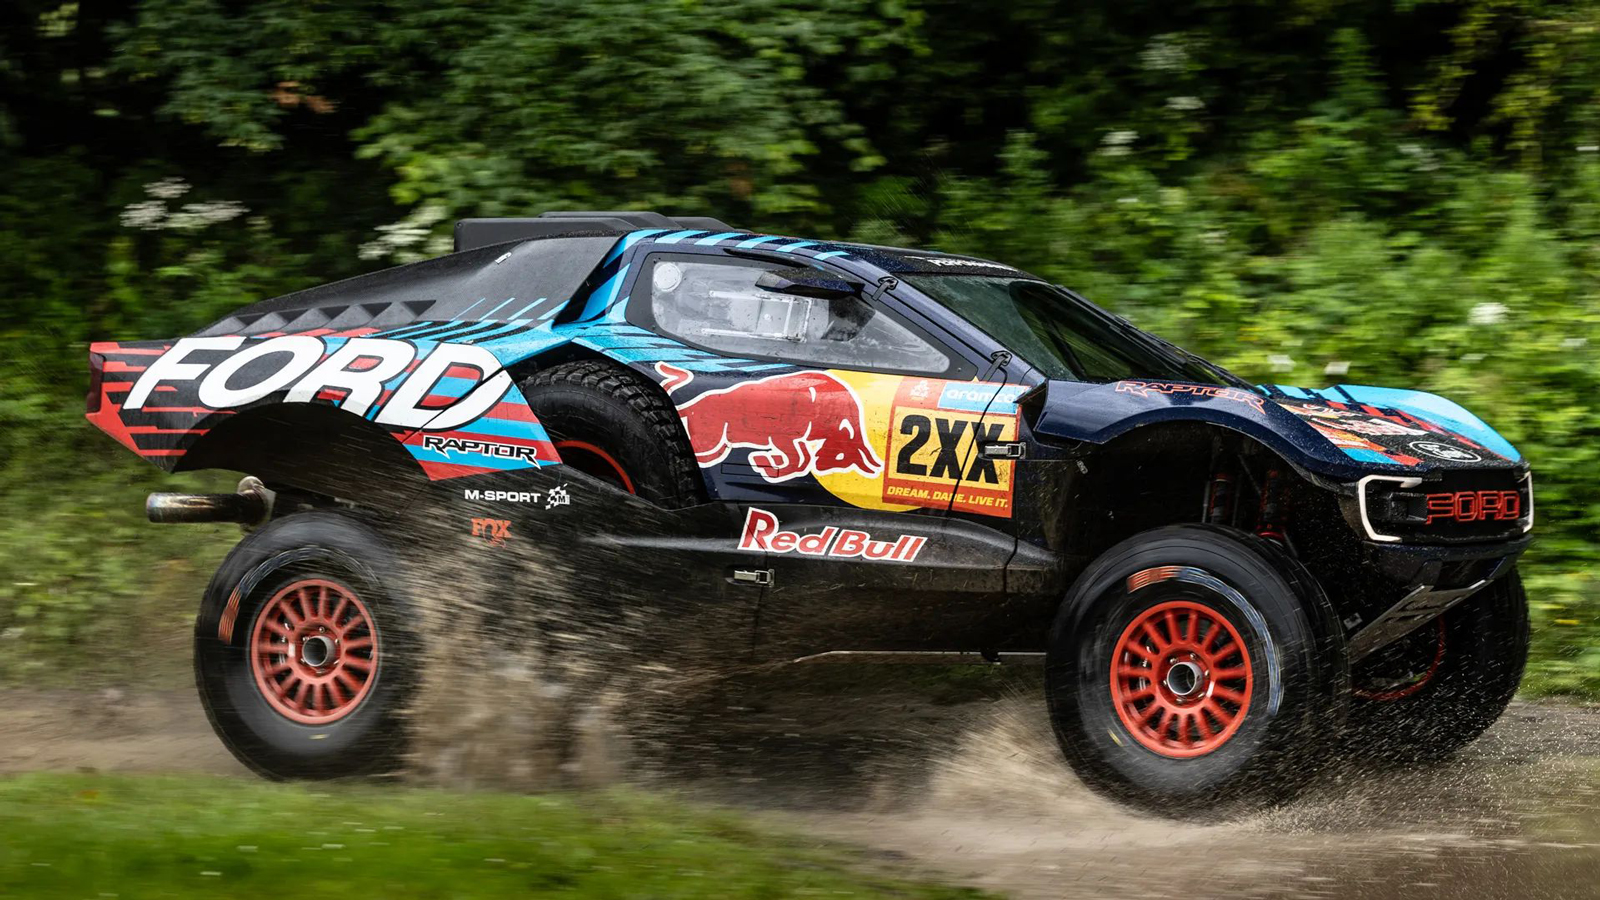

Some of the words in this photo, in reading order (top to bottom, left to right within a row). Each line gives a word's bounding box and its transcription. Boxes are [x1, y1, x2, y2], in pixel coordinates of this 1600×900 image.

[123, 336, 513, 429] FORD
[946, 389, 1015, 403] aramco
[1115, 380, 1266, 415] RAPTOR
[422, 434, 542, 470] RAPTOR
[896, 414, 1005, 485] 2XX
[464, 489, 541, 503] M-SPORT
[887, 486, 931, 499] DREAM.
[969, 495, 994, 506] LIVE
[995, 498, 1008, 507] IT.
[1426, 490, 1520, 525] FORD
[470, 517, 512, 543] FOX
[737, 506, 839, 556] Red
[828, 529, 928, 562] Bull
